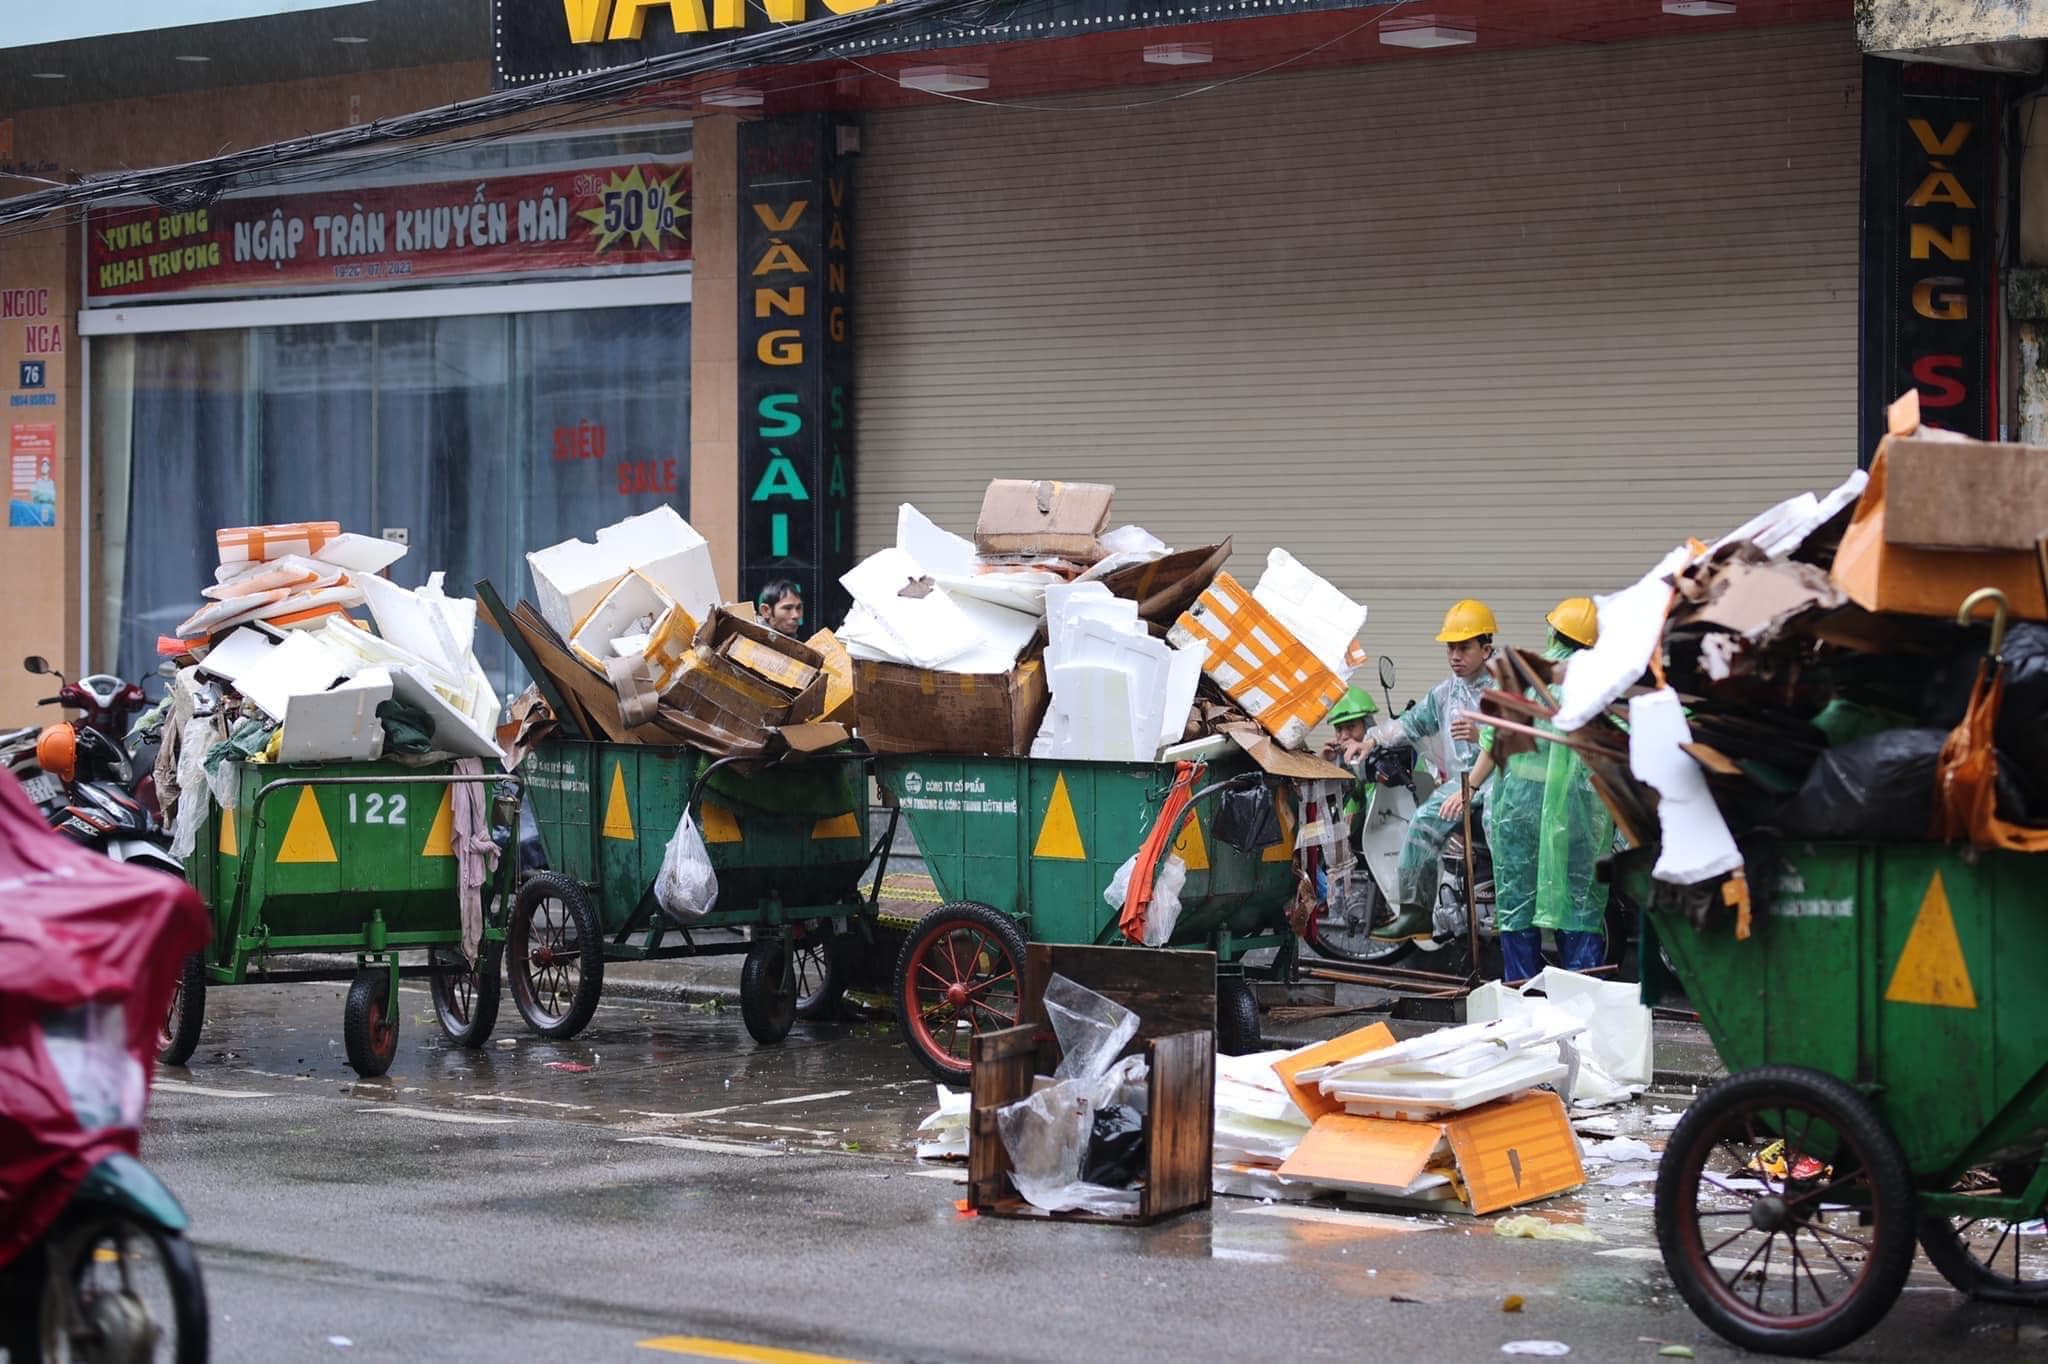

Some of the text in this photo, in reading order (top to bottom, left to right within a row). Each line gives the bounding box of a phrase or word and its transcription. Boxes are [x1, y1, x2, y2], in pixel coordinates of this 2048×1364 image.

[234, 183, 568, 270] NGẬP TRÀN KHUYẾN MÃI
[1904, 118, 1977, 320] VÀNG
[100, 242, 220, 288] KHAI TRƯƠNG
[752, 200, 810, 366] VÀNG
[26, 325, 62, 353] NGA
[24, 366, 39, 384] 76
[553, 417, 607, 462] SIÊU
[617, 458, 677, 496] SALE
[752, 393, 809, 557] SÀI
[349, 792, 407, 824] 122
